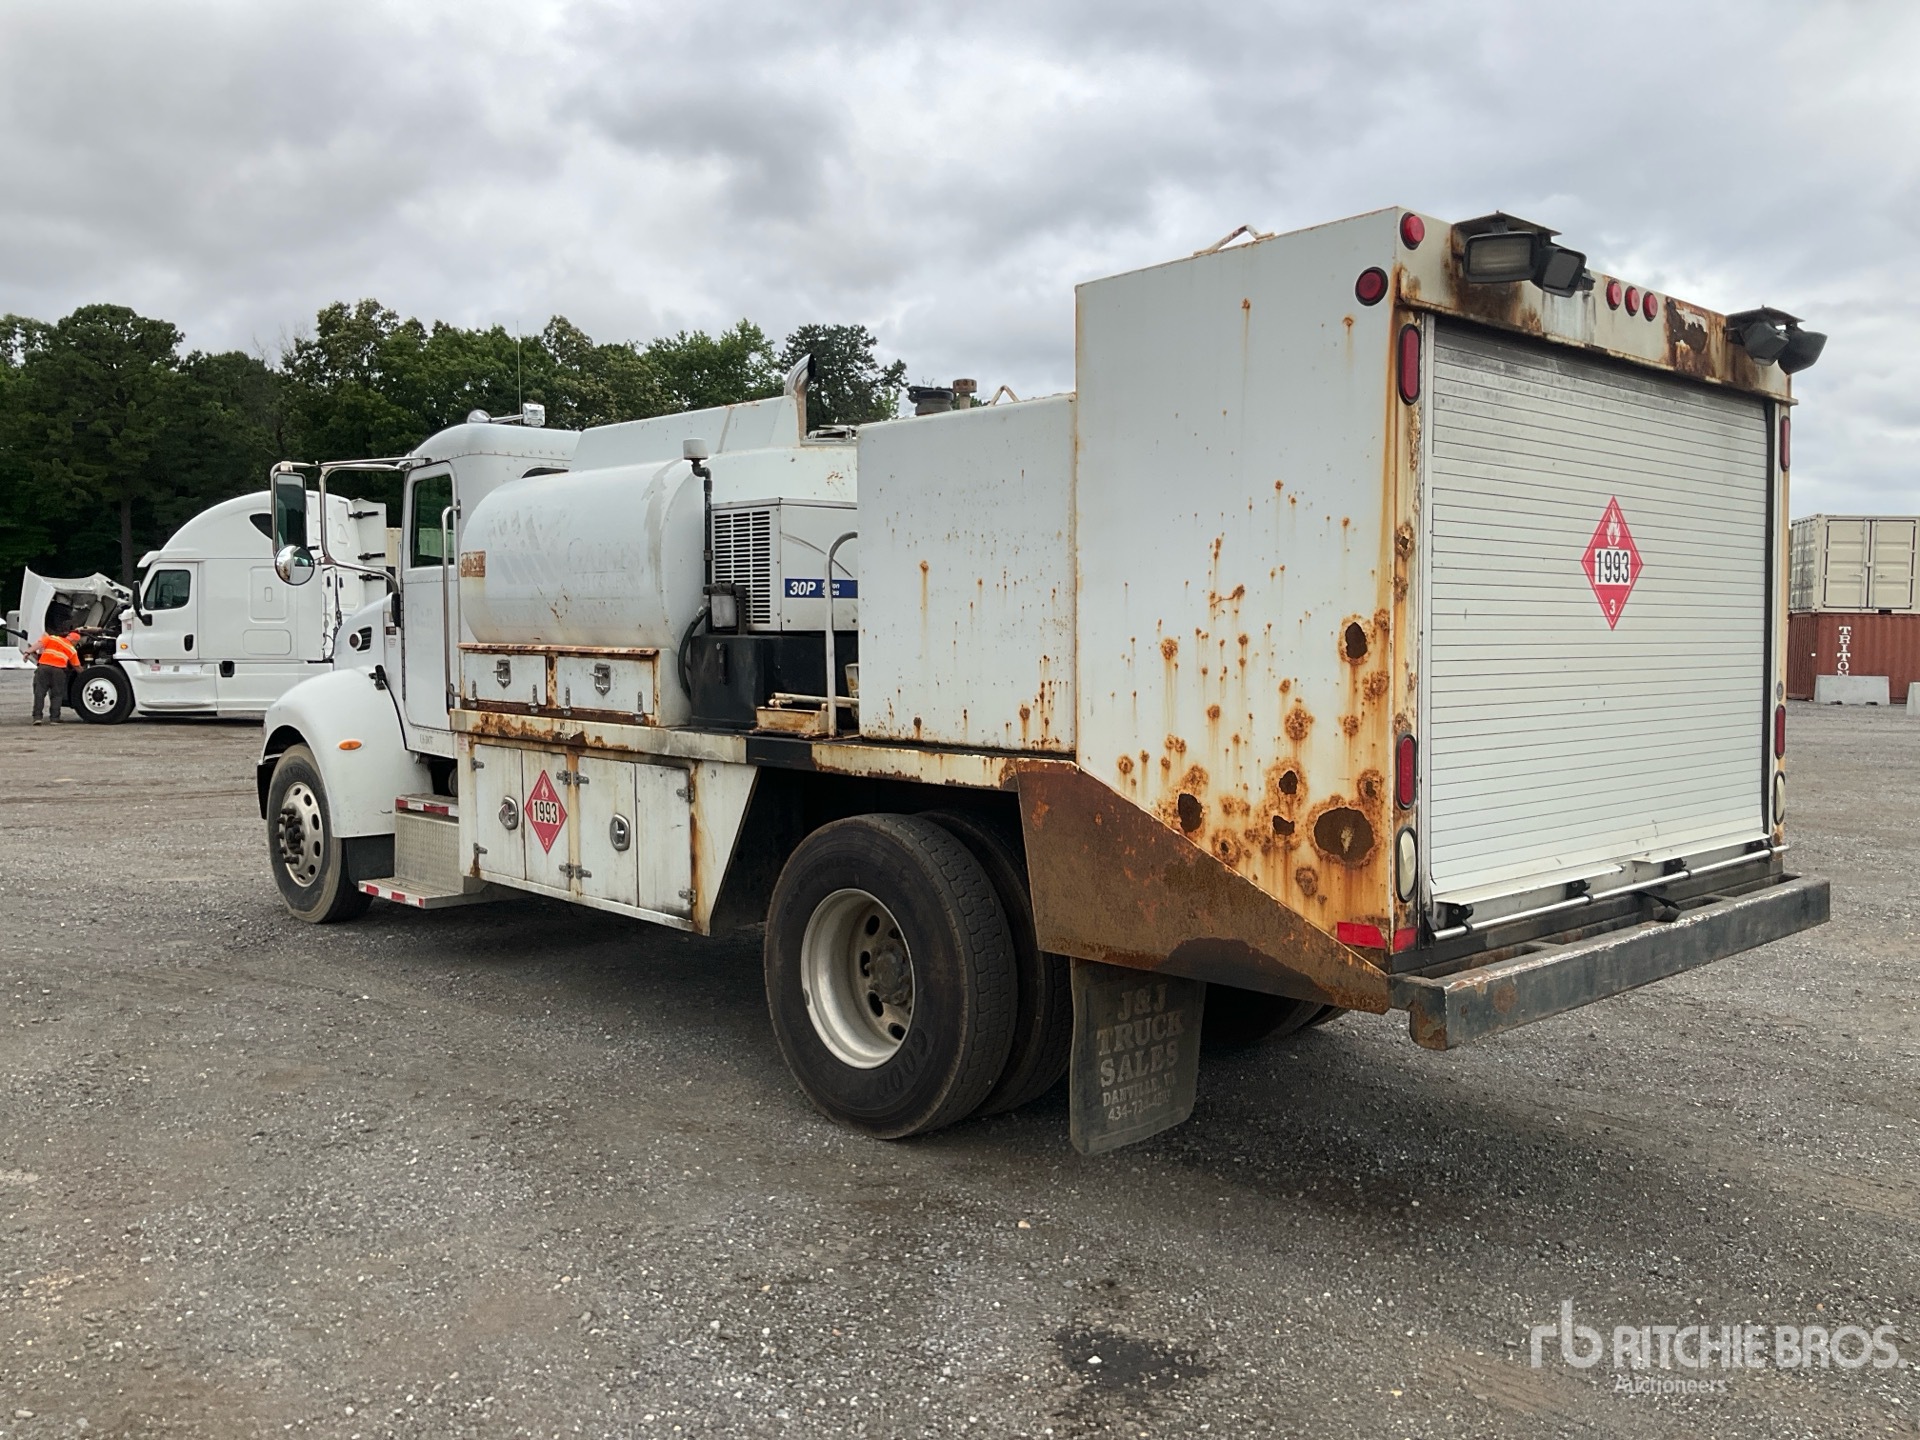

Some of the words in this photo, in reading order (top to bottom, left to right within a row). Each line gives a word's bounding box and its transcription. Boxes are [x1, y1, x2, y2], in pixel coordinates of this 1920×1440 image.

[1596, 550, 1630, 584] 1993
[789, 581, 816, 596] 30P
[1608, 599, 1616, 615] 3
[534, 801, 558, 824] 1993
[1117, 983, 1168, 1021] J&J
[1096, 1010, 1185, 1056] TRUCK
[1100, 1040, 1180, 1088] SALES
